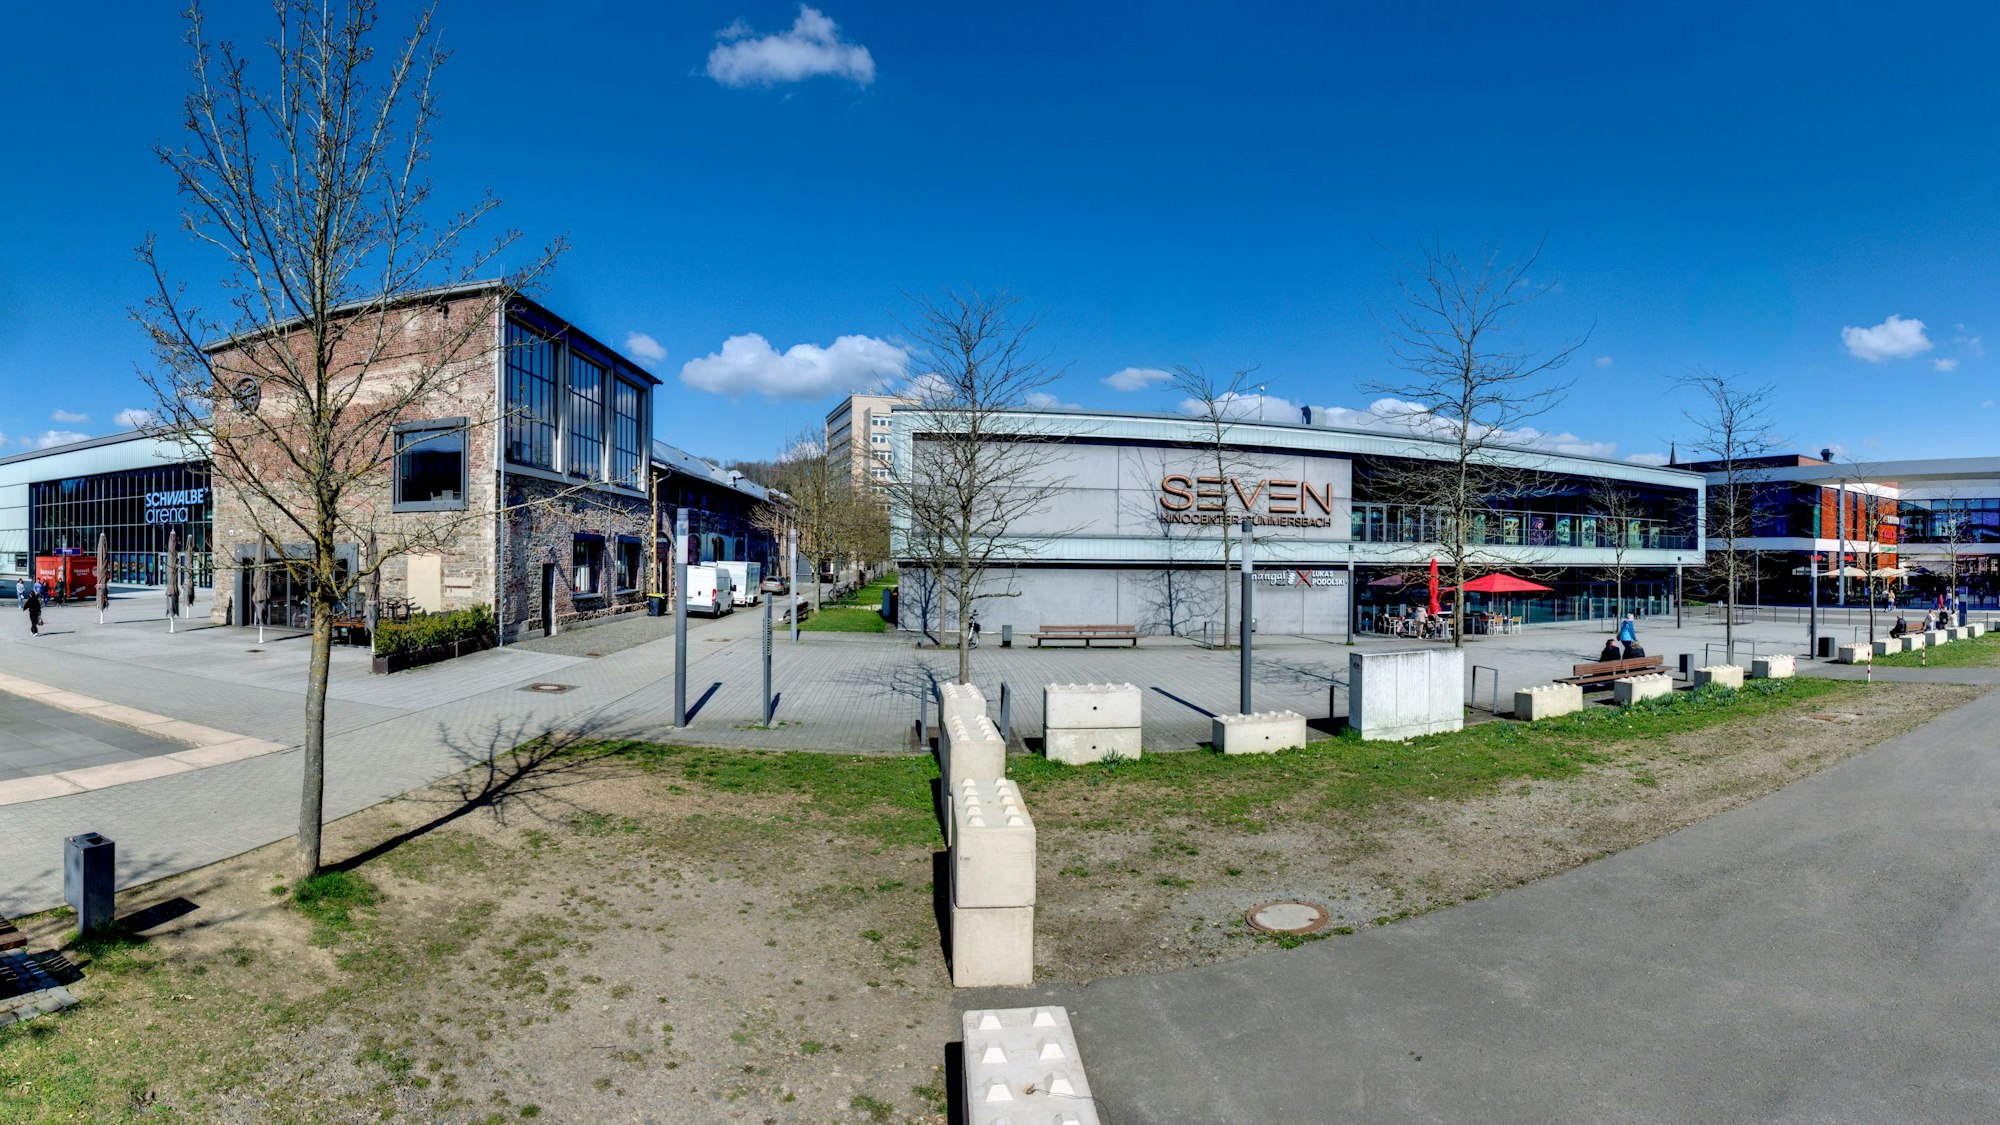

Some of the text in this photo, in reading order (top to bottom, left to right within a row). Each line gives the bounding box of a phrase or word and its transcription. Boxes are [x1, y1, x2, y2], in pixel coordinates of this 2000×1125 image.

[145, 488, 204, 507] SCHWALBE
[1160, 474, 1332, 515] SEVEN
[145, 506, 189, 524] arena
[1160, 511, 1240, 526] KINOCENTER
[1312, 570, 1334, 578] LUKAS
